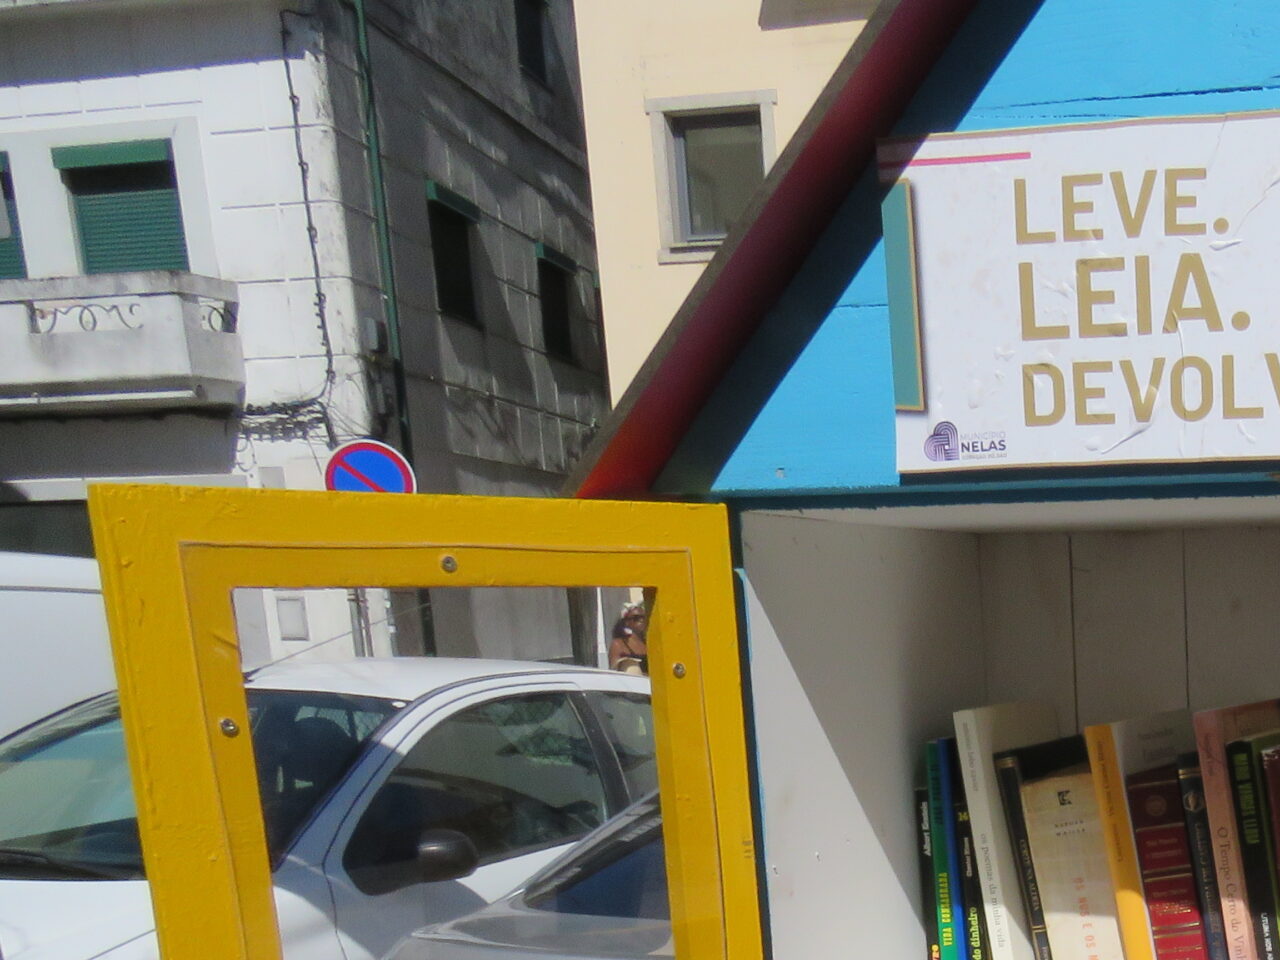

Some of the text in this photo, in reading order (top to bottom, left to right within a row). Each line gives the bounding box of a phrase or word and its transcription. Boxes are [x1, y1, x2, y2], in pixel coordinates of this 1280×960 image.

[1014, 167, 1231, 245] LEVE.
[1018, 252, 1251, 341] LEIA.
[961, 440, 1007, 453] NELAS
[1217, 827, 1229, 839] O
[1219, 841, 1232, 876] Tempo
[981, 834, 1005, 949] os poemas da minha vida
[1226, 882, 1238, 916] Certo
[942, 927, 953, 946] VIDA
[968, 907, 981, 947] dinheiro
[1231, 919, 1239, 932] do
[1085, 934, 1096, 948] OS
[972, 949, 982, 960] do
